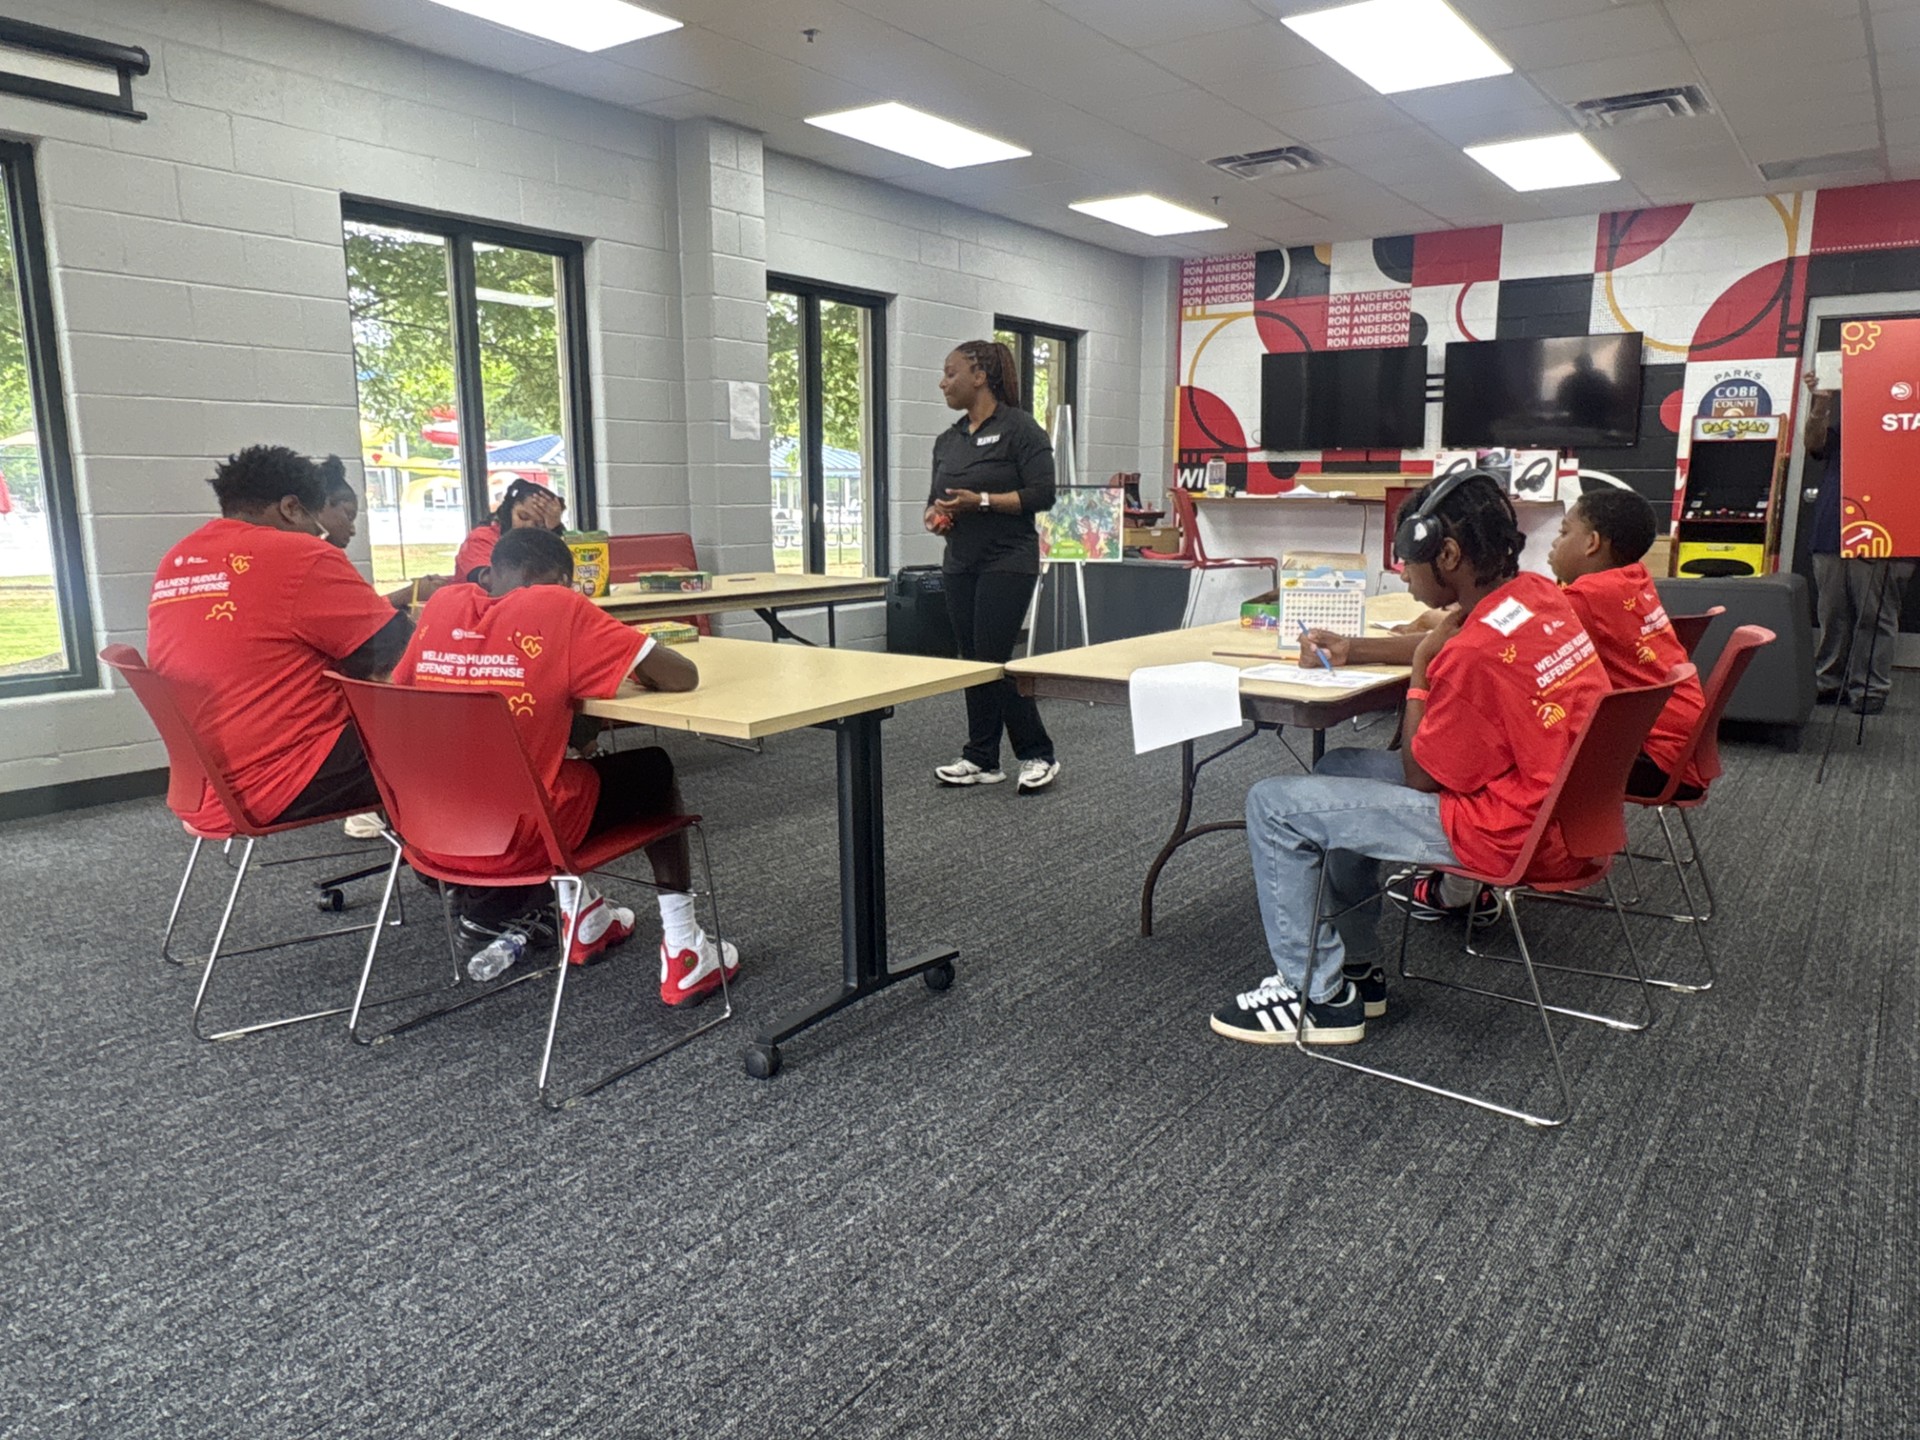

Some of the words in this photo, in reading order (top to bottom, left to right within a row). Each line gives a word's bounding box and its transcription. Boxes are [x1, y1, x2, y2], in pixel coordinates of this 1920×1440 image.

[1183, 266, 1203, 276] RON
[1205, 261, 1255, 274] ANDERSON
[1183, 277, 1203, 286] RON
[1205, 272, 1255, 284] ANDERSON
[1183, 287, 1203, 296] RON
[1204, 282, 1254, 295] ANDERSON
[1182, 297, 1202, 306] RON
[1204, 292, 1254, 304] ANDERSON
[1329, 294, 1351, 304] RON
[1353, 290, 1411, 303] ANDERSON
[1328, 304, 1351, 315] RON
[1353, 301, 1410, 313] ANDERSON
[1328, 315, 1350, 326] RON
[1352, 312, 1410, 324] ANDERSON
[1327, 326, 1350, 337] RON
[1352, 322, 1409, 335] ANDERSON
[1326, 337, 1349, 348] RON
[1351, 333, 1409, 346] ANDERSON
[1714, 369, 1762, 382] PARKS
[1715, 386, 1758, 397] COBB
[1715, 400, 1755, 408] COUNTY
[1702, 419, 1769, 434] PAC-MAN
[178, 586, 189, 595] TO
[190, 581, 231, 593] OFFENSE
[467, 654, 519, 665] HUDDLE:
[1534, 641, 1575, 673] WELLNESS
[416, 662, 455, 676] DEFENSE
[469, 667, 525, 678] OFFENSE
[1536, 657, 1576, 688] DEFENSE
